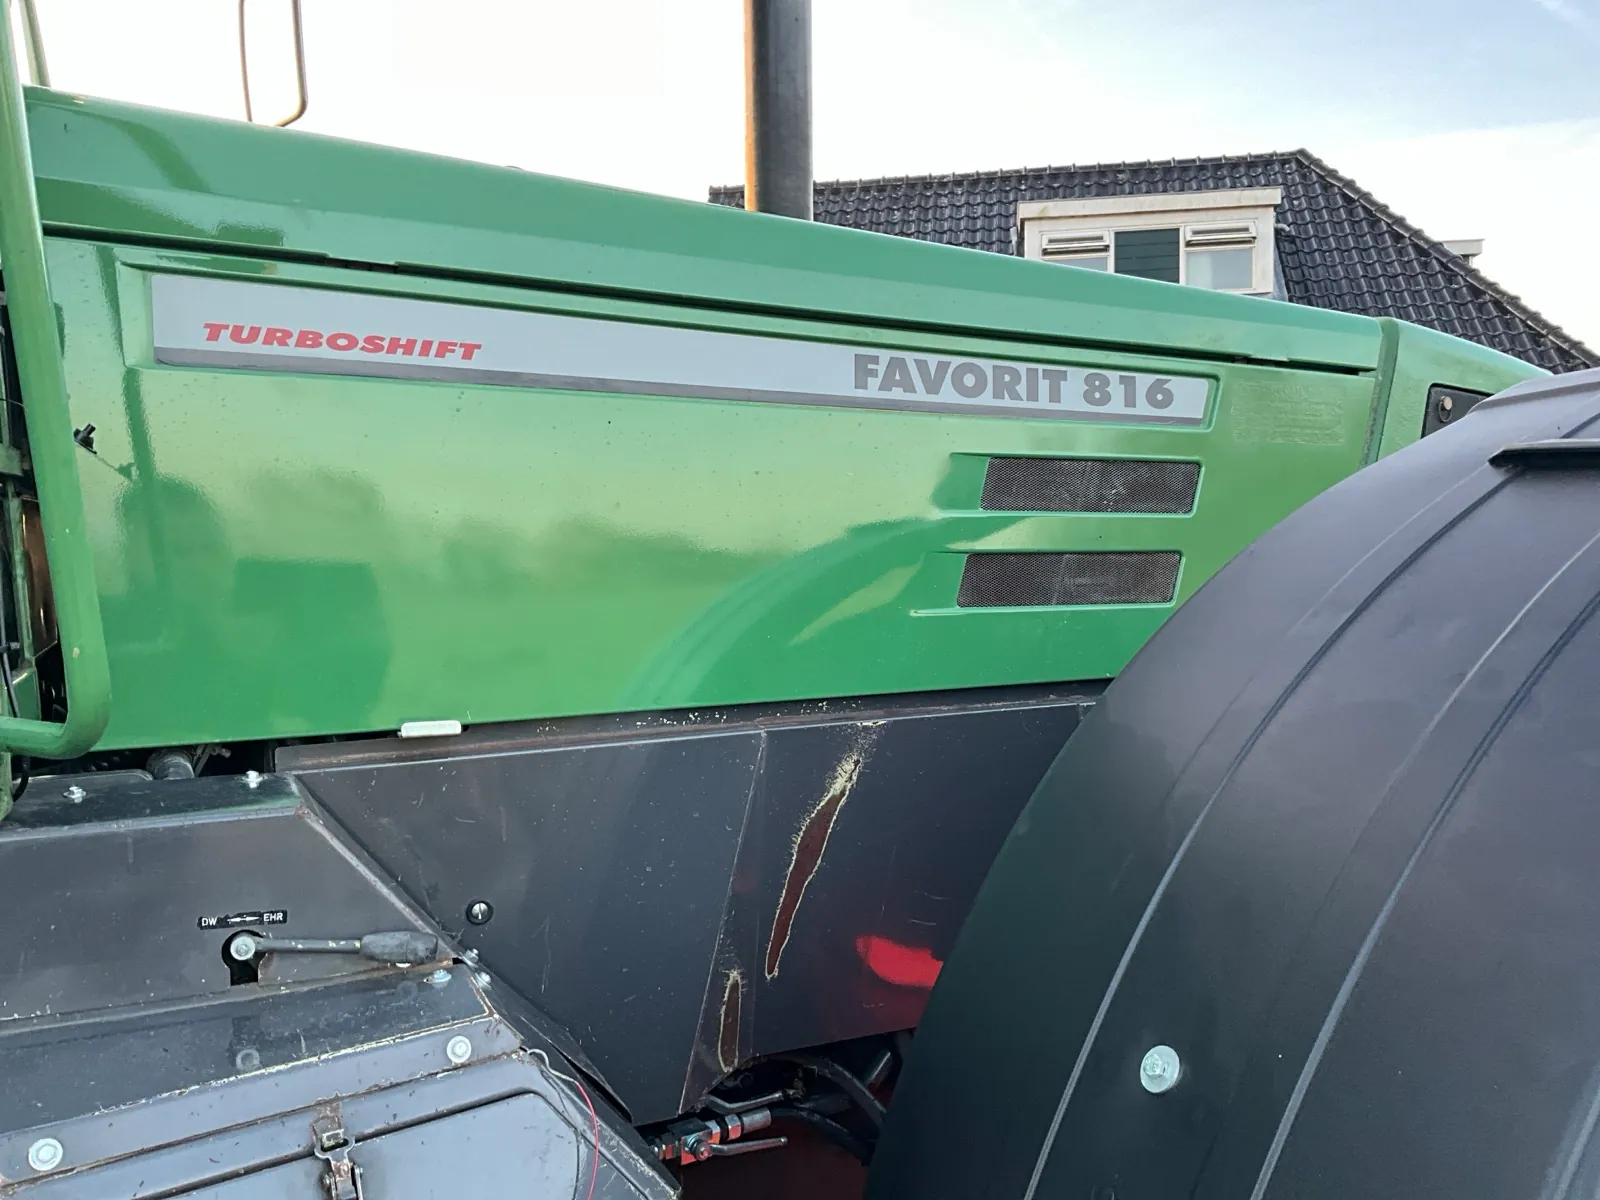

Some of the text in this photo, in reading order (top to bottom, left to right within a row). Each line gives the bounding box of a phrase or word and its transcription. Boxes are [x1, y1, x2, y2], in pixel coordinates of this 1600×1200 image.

[203, 322, 482, 361] TURBOSHIFT
[853, 353, 1175, 410] FAVORIT 816
[201, 912, 284, 926] DW EHR
